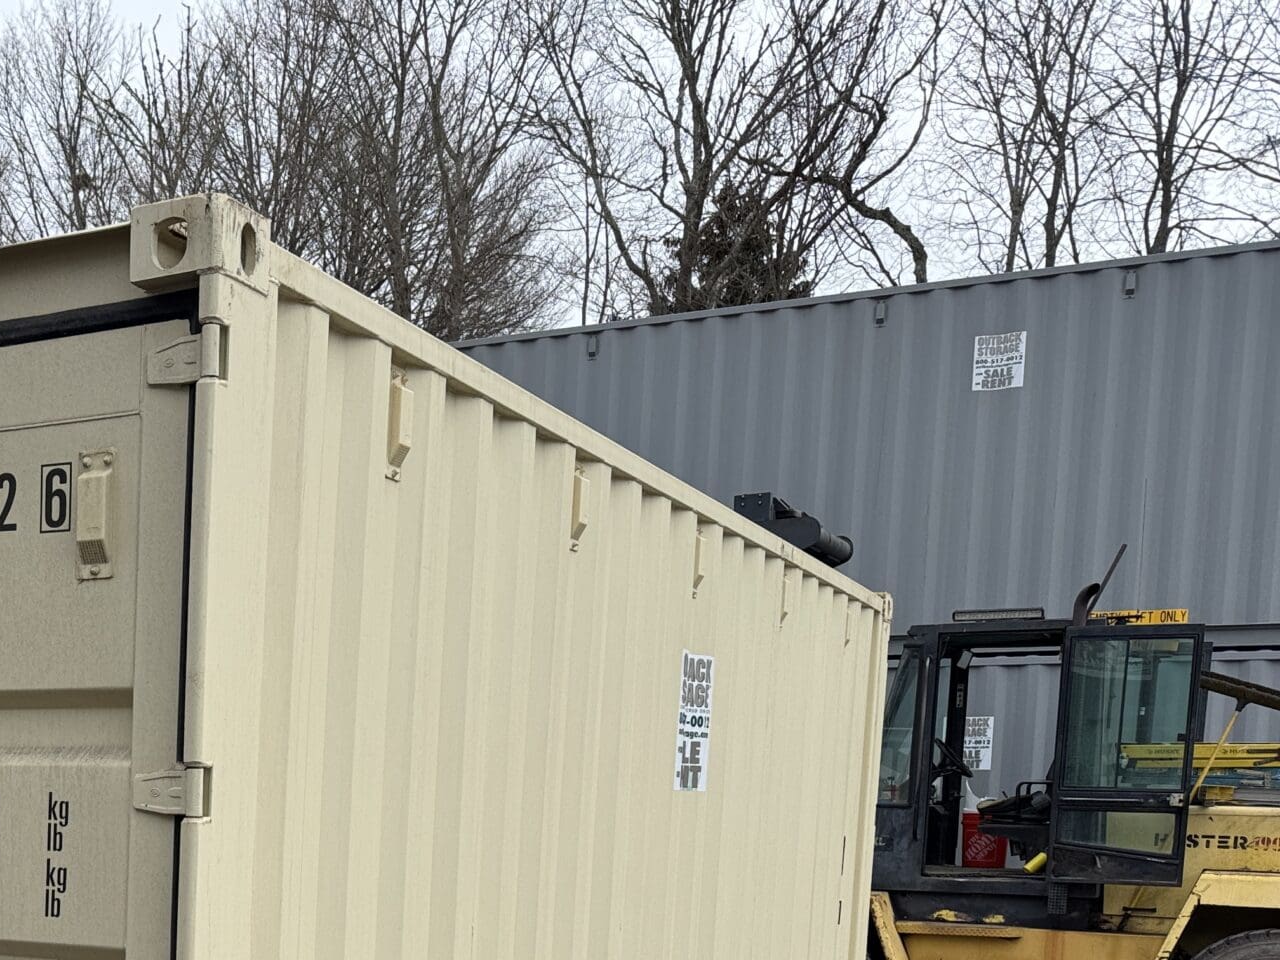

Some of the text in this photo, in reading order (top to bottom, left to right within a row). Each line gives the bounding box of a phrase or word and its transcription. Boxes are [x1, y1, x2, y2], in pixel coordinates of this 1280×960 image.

[981, 376, 1014, 389] RENT
[983, 367, 1013, 378] SALE
[44, 467, 68, 529] 6
[1160, 611, 1187, 623] ONLY
[47, 792, 69, 827] kg
[47, 822, 63, 852] lb
[46, 858, 67, 893] kg
[44, 889, 61, 918] lb
